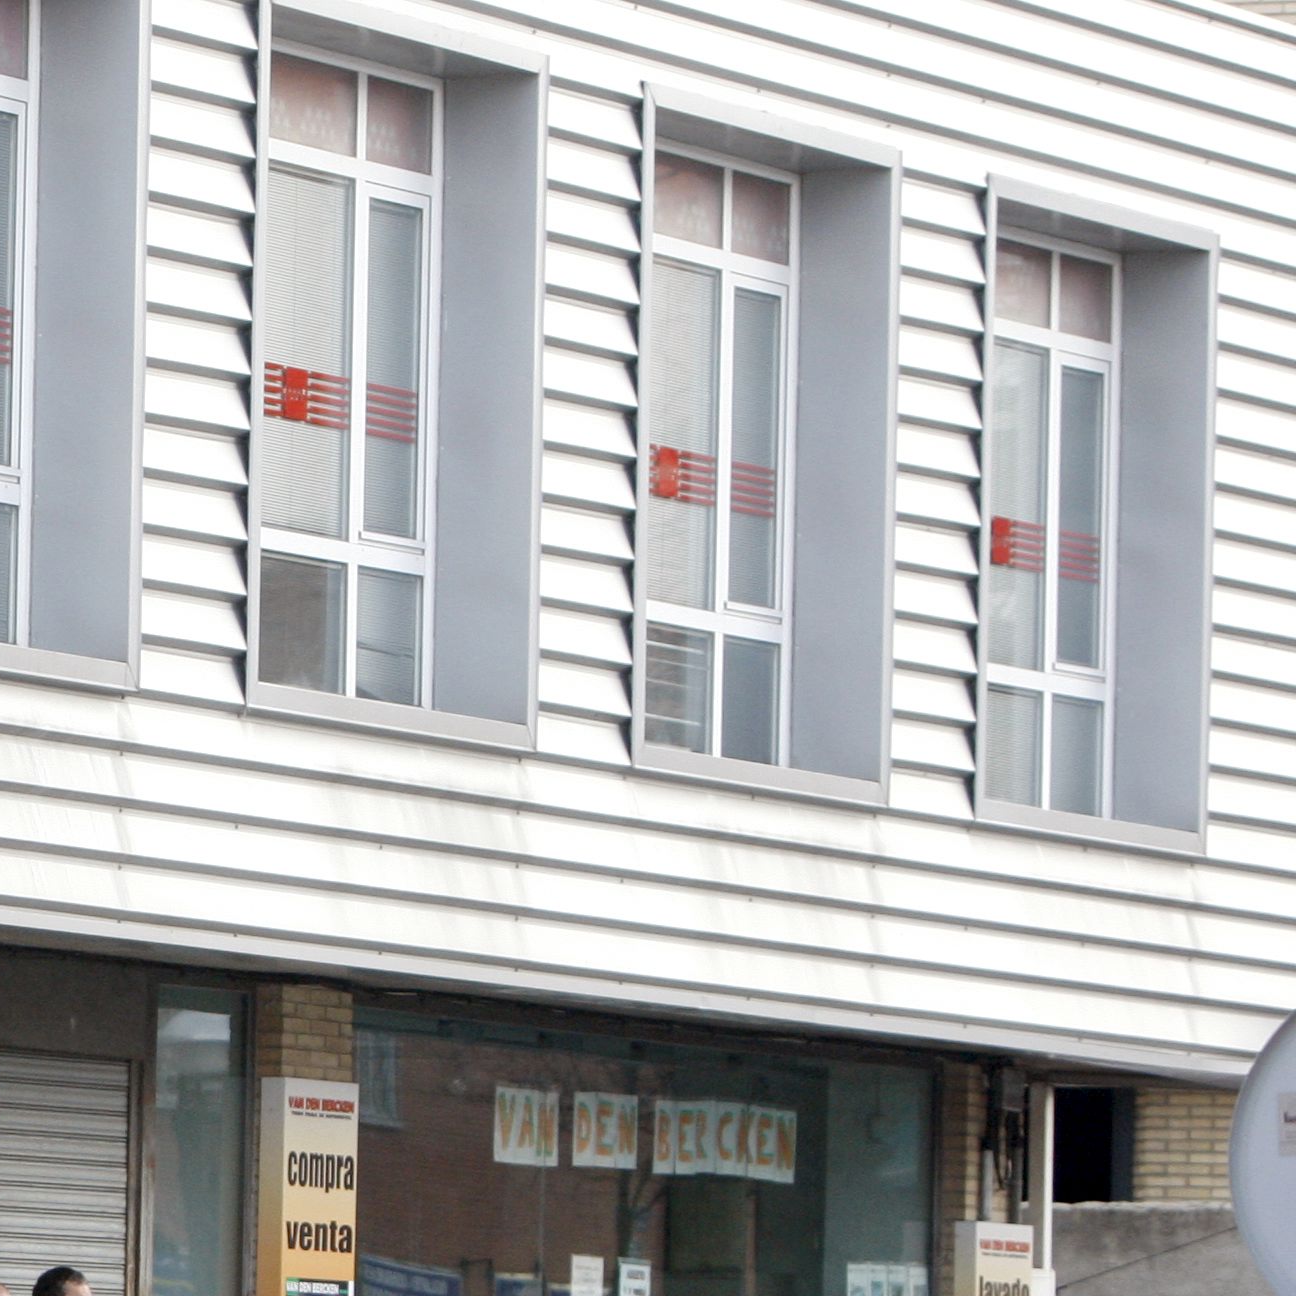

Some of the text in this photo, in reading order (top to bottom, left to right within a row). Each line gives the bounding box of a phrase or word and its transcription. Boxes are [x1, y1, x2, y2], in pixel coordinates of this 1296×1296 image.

[288, 1096, 305, 1109] VAN
[306, 1097, 320, 1111] DEN
[498, 1091, 795, 1170] VAN DEN BERCKEN
[288, 1150, 354, 1193] compra
[286, 1220, 353, 1253] venta
